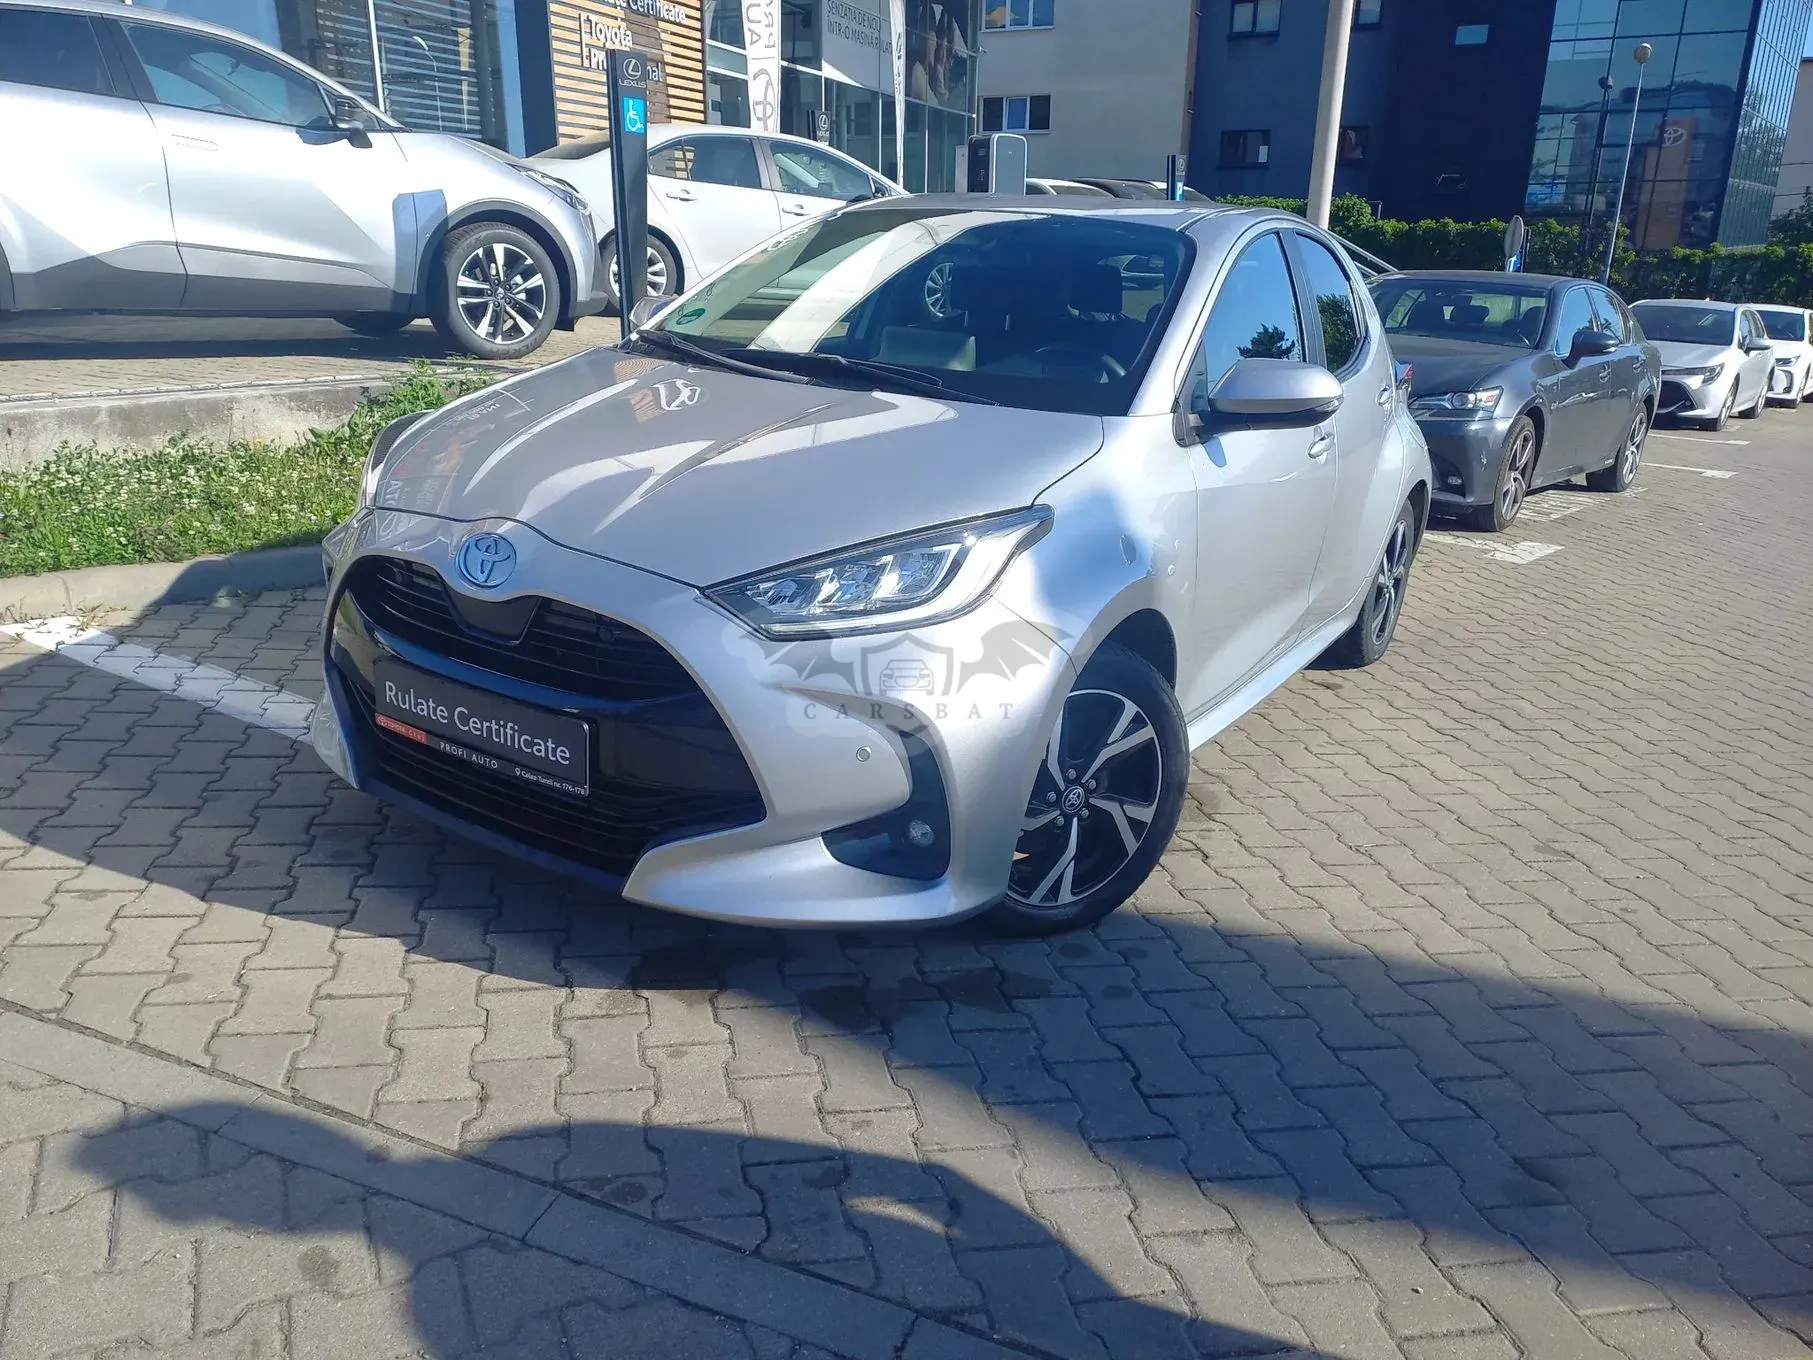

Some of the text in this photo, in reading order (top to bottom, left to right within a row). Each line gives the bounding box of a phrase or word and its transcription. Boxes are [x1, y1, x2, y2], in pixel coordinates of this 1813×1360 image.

[588, 14, 633, 48] Toyota
[619, 79, 646, 88] LEXUS
[385, 680, 570, 765] Rulate Certificate
[440, 741, 498, 769] PROFI AUTO
